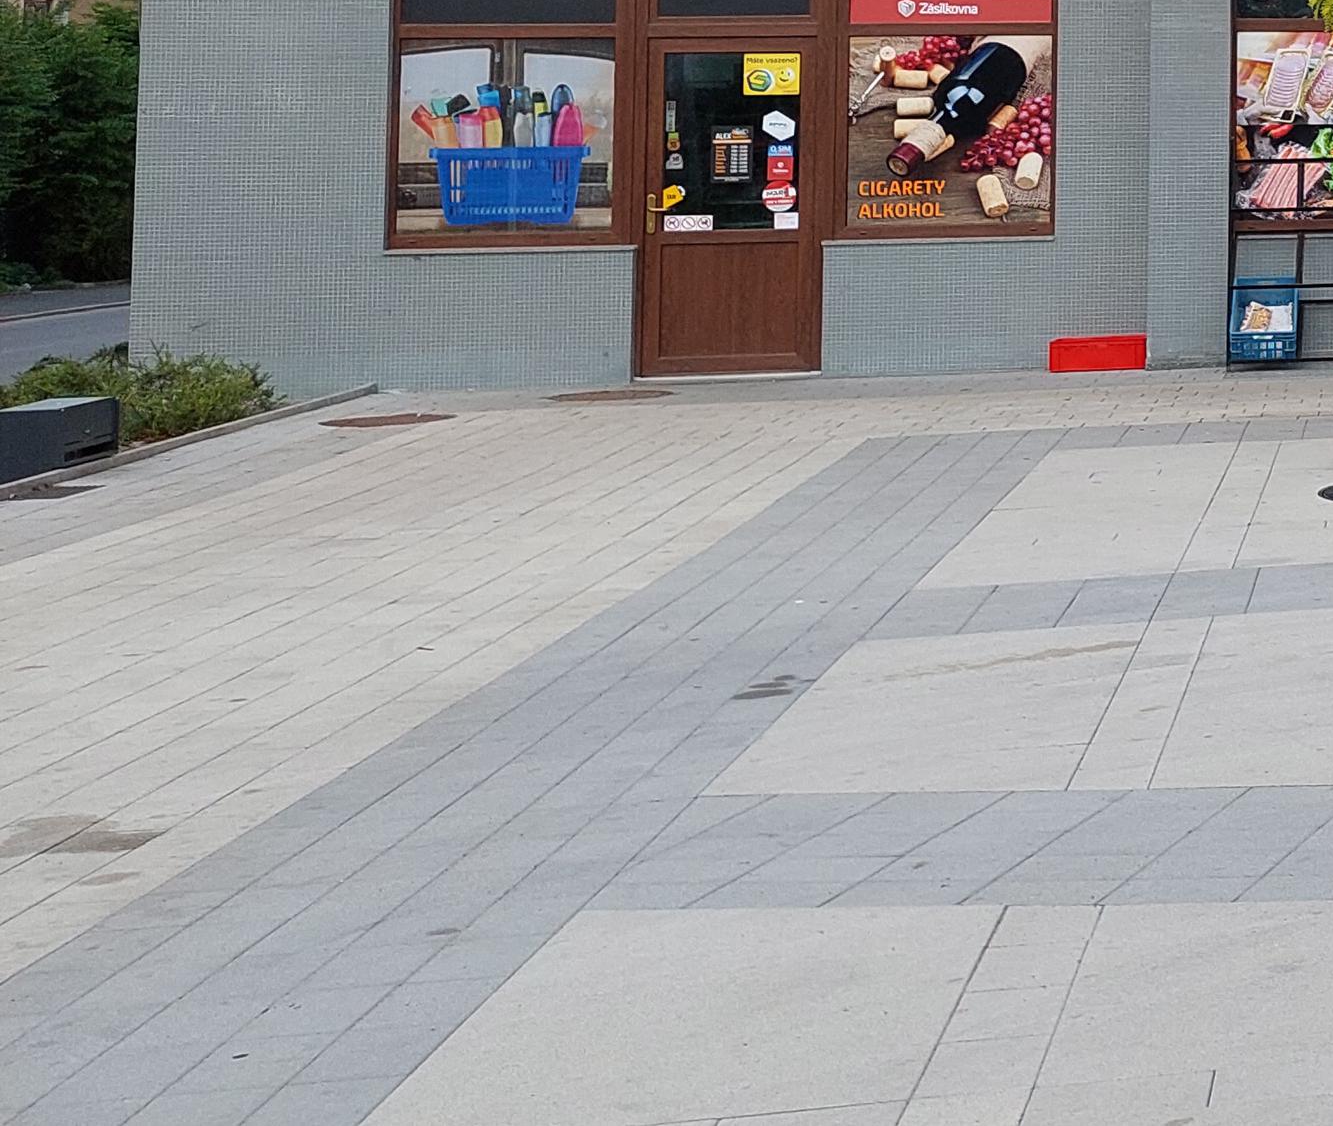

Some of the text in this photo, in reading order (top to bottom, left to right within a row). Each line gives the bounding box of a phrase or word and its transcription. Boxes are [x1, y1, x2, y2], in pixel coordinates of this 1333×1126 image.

[918, 2, 979, 15] Zásilkovna
[858, 180, 946, 196] CIGARETY
[858, 202, 945, 219] ALKOHOL
